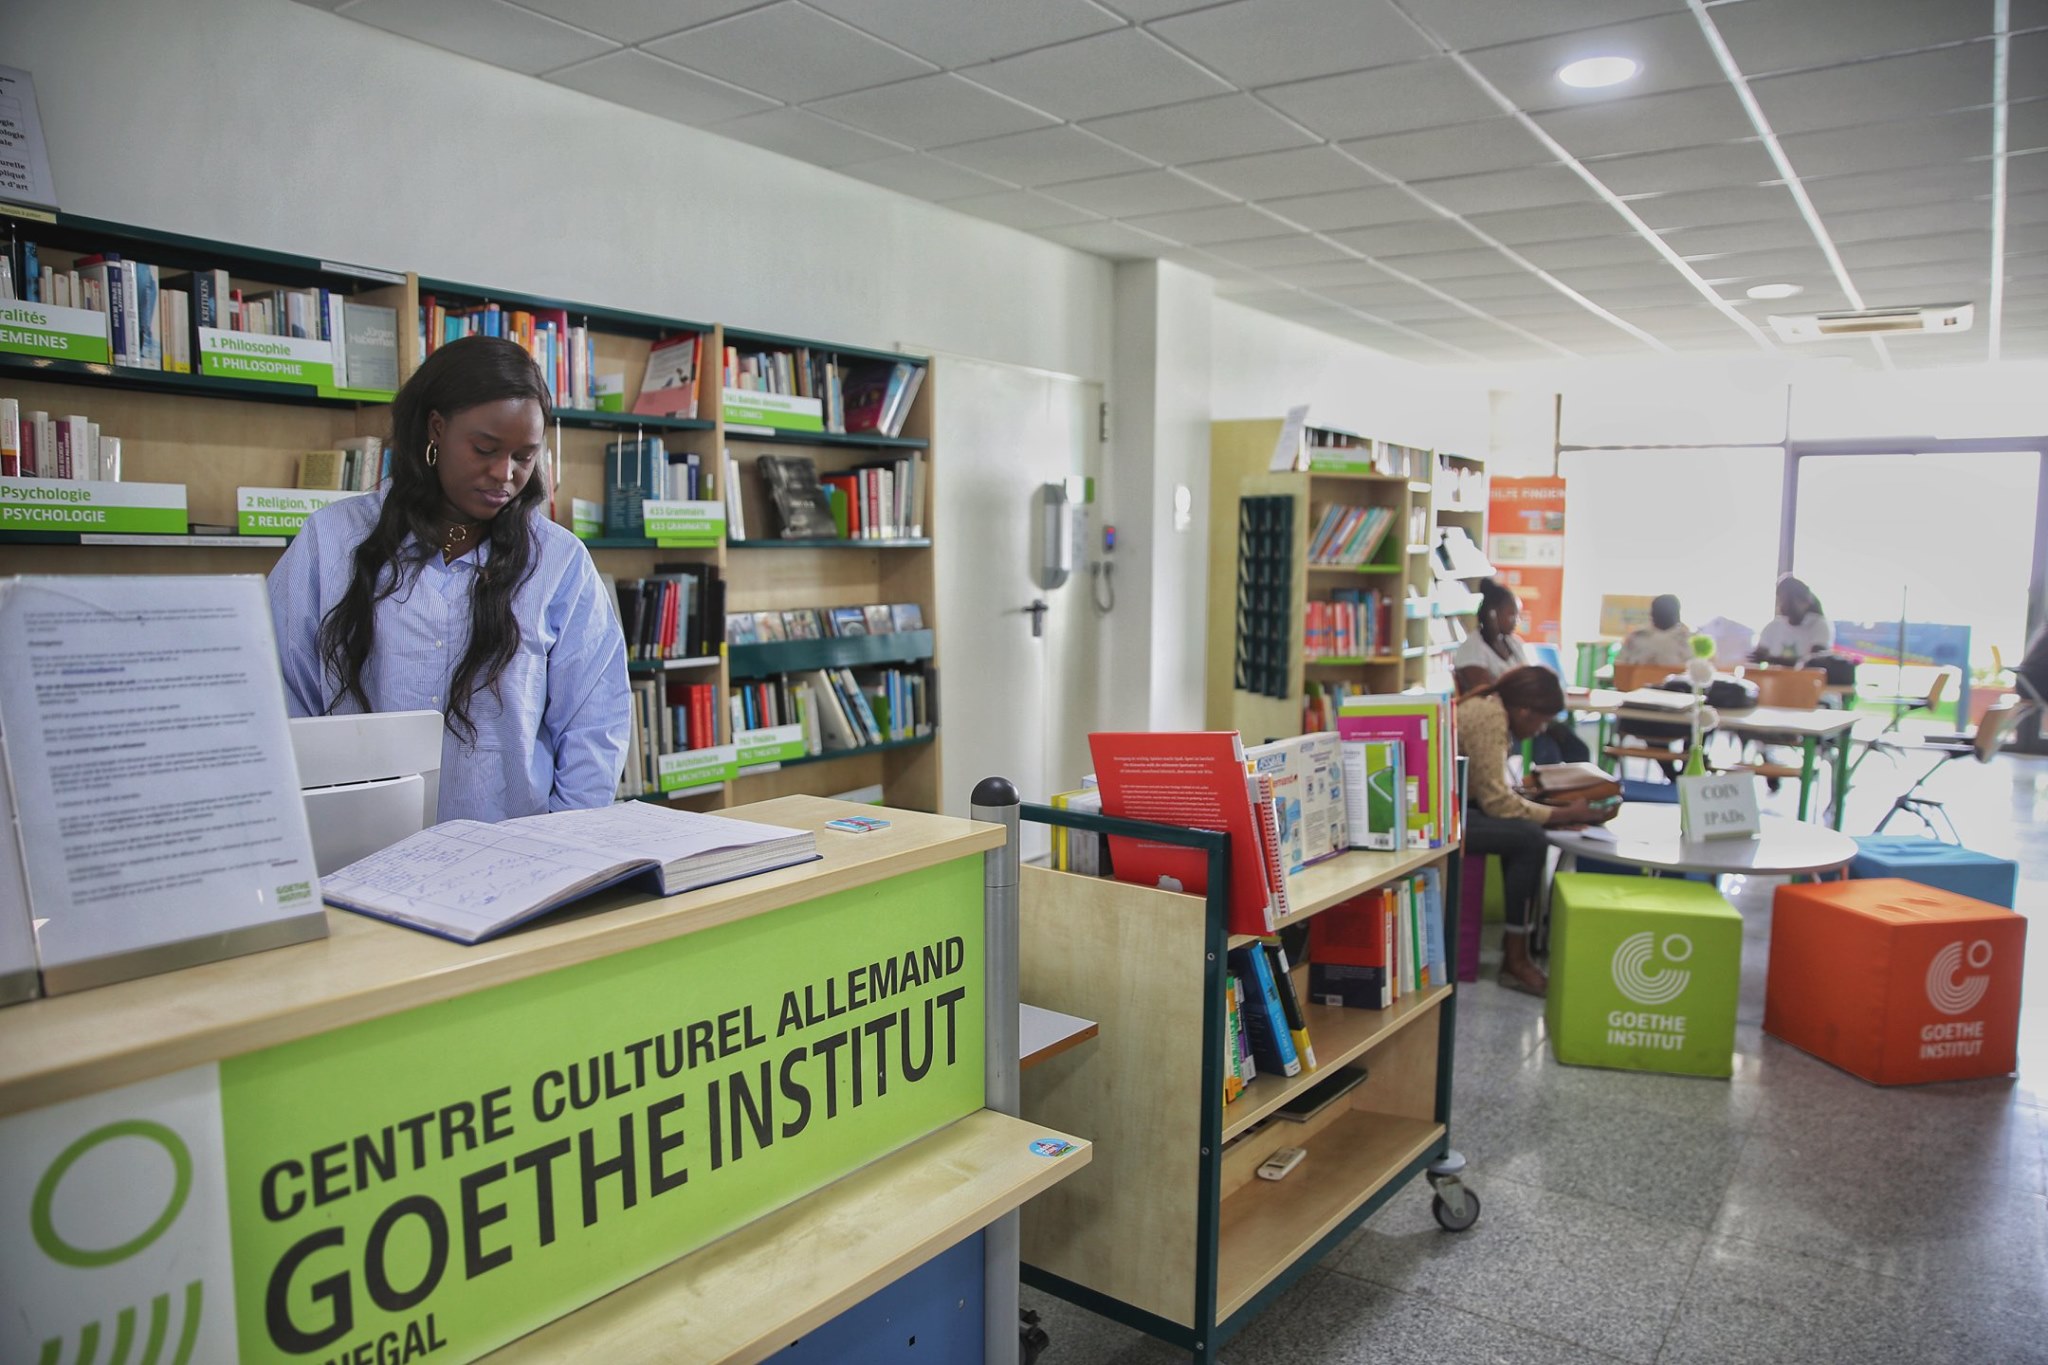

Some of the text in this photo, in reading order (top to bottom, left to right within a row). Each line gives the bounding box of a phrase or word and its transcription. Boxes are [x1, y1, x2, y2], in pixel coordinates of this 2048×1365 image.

[210, 337, 291, 356] 1 Philosophie
[212, 357, 303, 376] 1 PHILOSOPHIE
[1, 486, 91, 502] Psychologie
[246, 496, 254, 507] 2
[257, 497, 307, 510] Religion,
[3, 507, 106, 524] PSYCHOLOGIE
[247, 516, 307, 528] 2 RELIGIO
[1701, 784, 1739, 801] COIN
[1704, 809, 1746, 826] IPADs
[1608, 1010, 1687, 1033] GOETHE
[1921, 1021, 1983, 1041] GOETHE
[1607, 1029, 1686, 1051] INSTITUT
[1920, 1040, 1982, 1060] INSTITUT
[260, 936, 966, 1224] CENTRE CULTUREL ALLEMAND
[264, 986, 967, 1356] GOETHE INSTITUT
